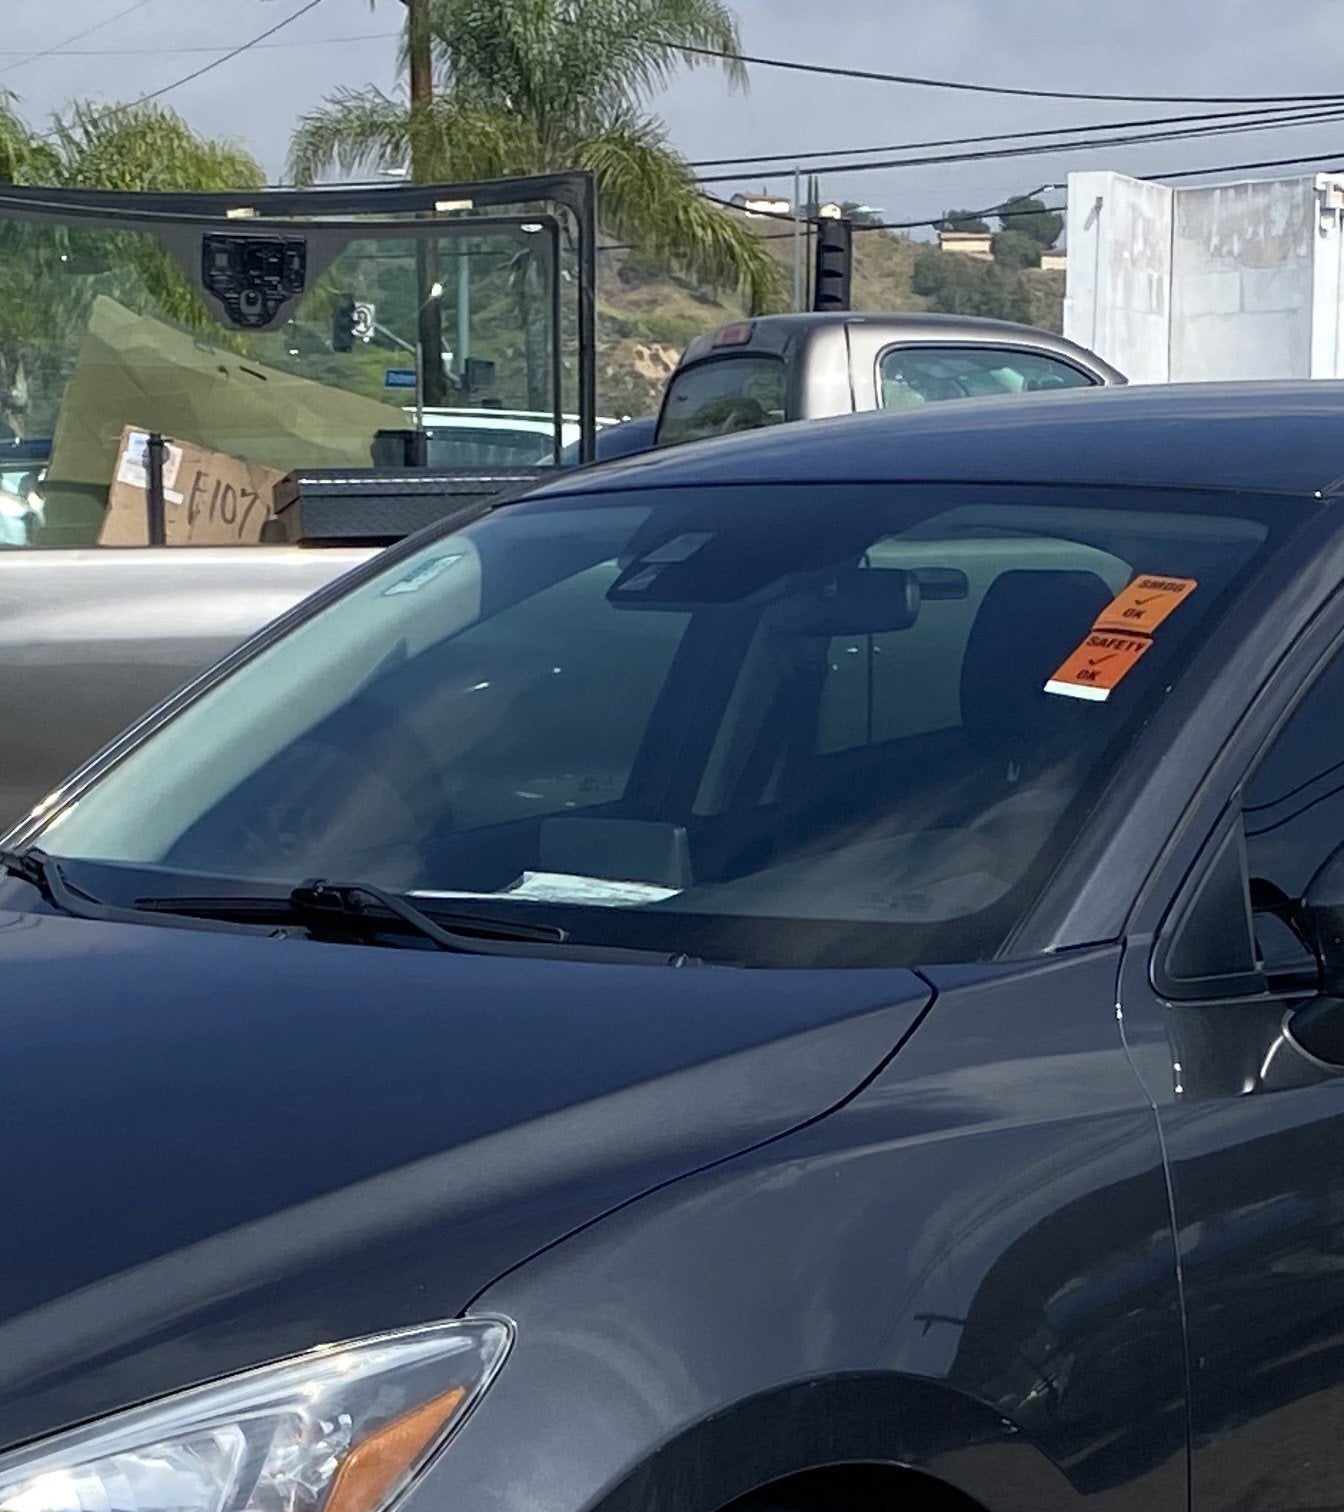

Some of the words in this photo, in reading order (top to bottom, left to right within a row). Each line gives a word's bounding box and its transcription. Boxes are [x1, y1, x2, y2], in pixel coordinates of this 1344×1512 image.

[1137, 580, 1186, 592] SMOG
[1122, 608, 1146, 619] OK
[1086, 636, 1148, 652] SAFETY
[1076, 669, 1101, 681] OK
